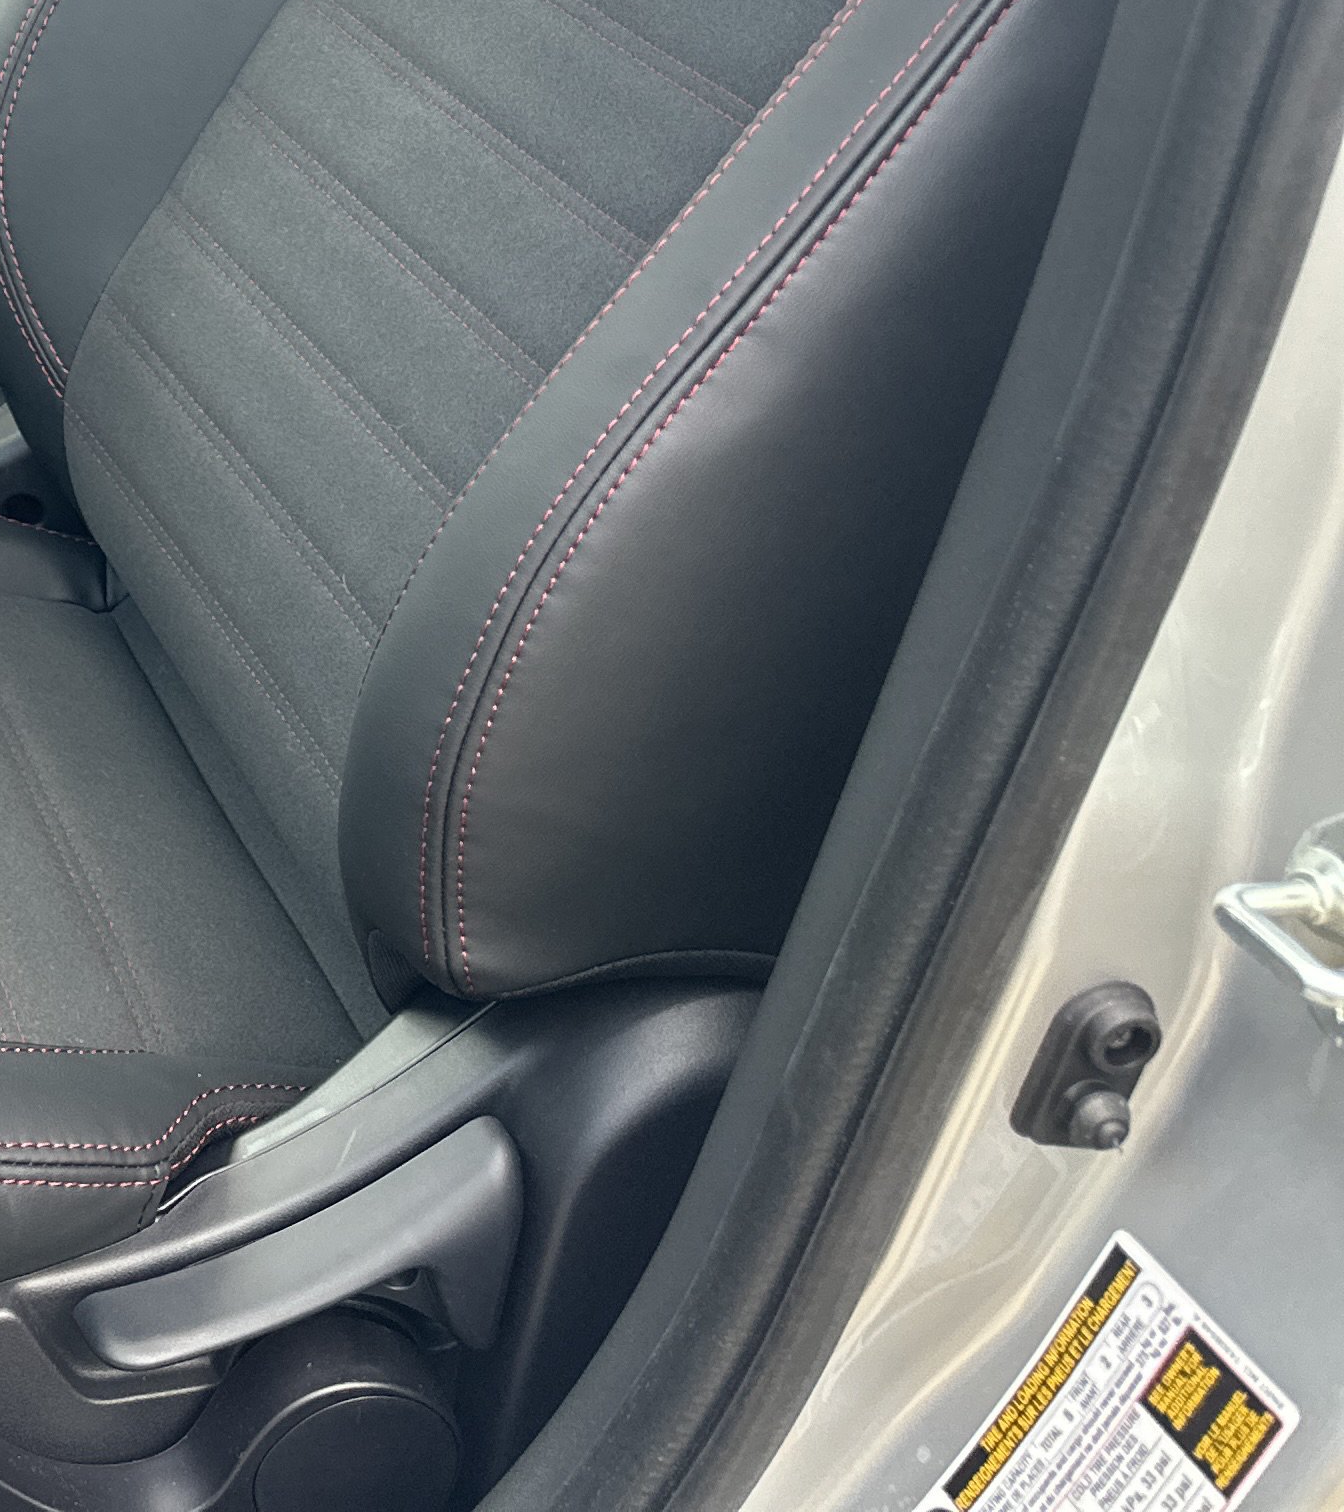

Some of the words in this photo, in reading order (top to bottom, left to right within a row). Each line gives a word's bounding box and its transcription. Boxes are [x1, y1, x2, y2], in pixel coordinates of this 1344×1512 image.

[979, 1423, 1003, 1453] TIRE
[995, 1402, 1019, 1433] AND
[1011, 1360, 1051, 1411] LOADING
[1042, 1294, 1095, 1368] INFORMATION
[1016, 1403, 1039, 1432] SUR
[1031, 1384, 1053, 1411] LES
[1045, 1352, 1076, 1392] PNEUS
[1067, 1338, 1085, 1360] ET
[1076, 1324, 1095, 1347] LE
[1086, 1258, 1138, 1333] CHARGEMENT
